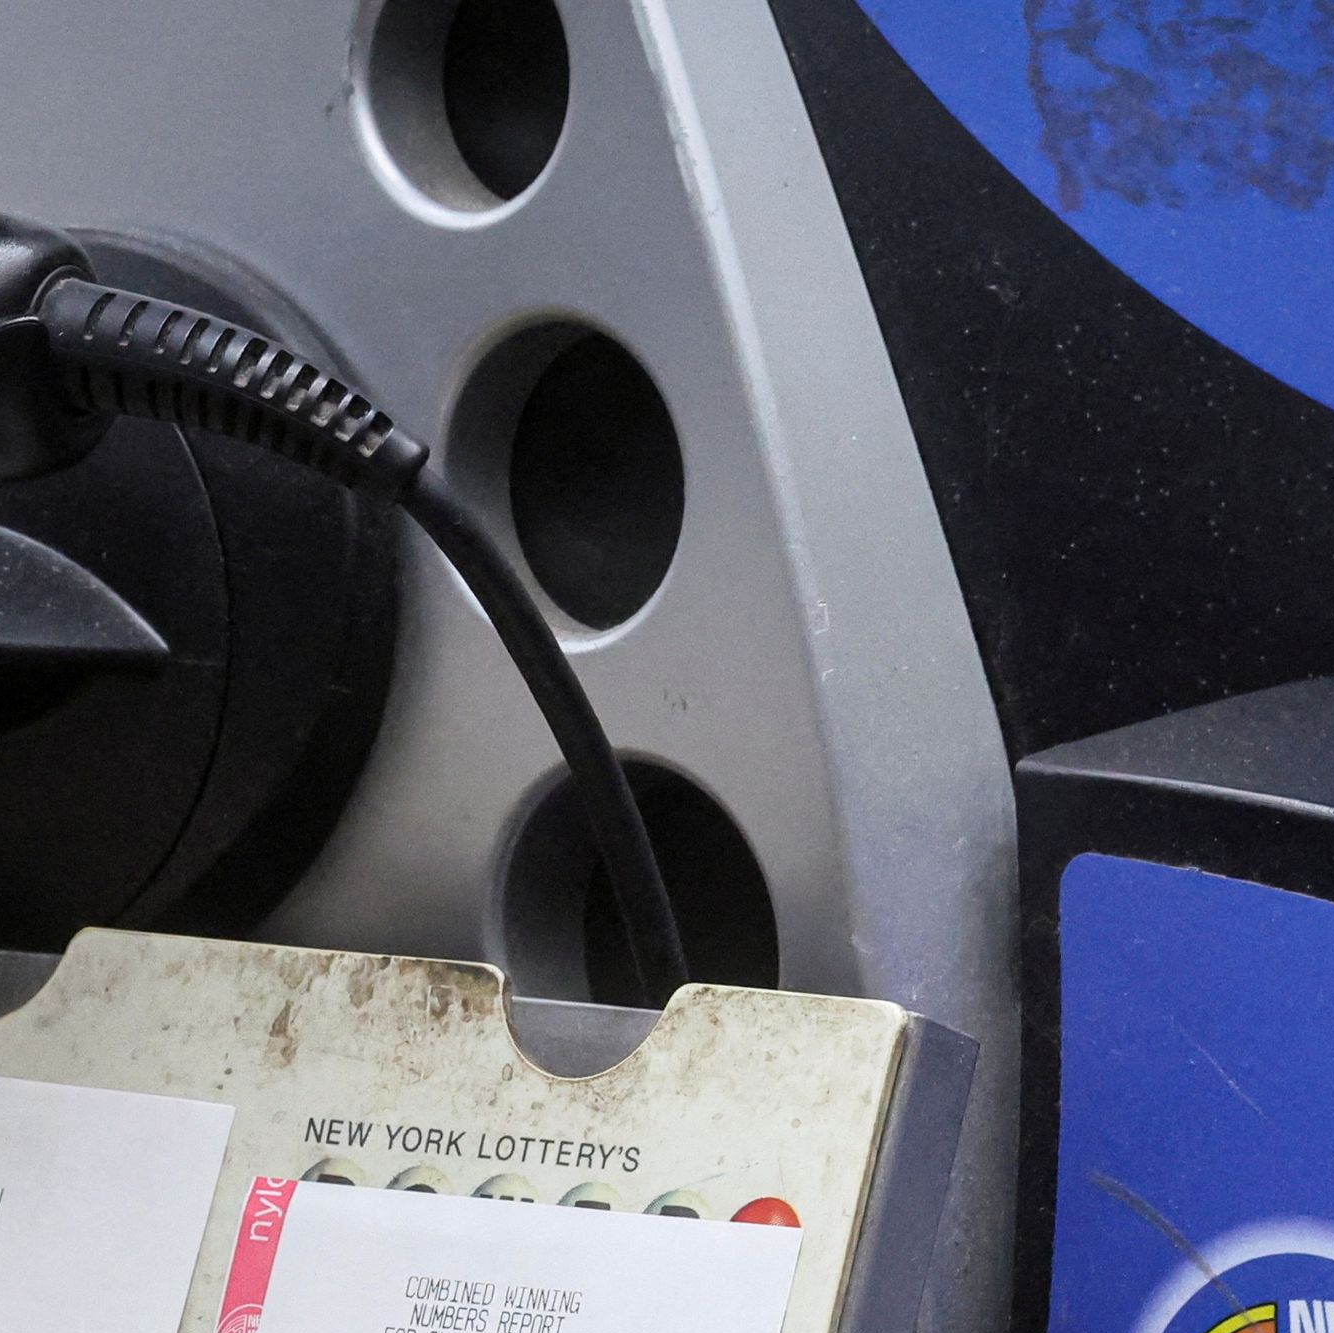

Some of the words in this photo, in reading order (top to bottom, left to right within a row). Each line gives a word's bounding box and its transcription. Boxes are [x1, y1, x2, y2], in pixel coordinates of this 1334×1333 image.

[305, 1117, 373, 1148] NEW
[385, 1124, 466, 1157] YORK
[477, 1133, 641, 1173] LOTTERY'S
[405, 1276, 495, 1306] COMBINED
[505, 1285, 583, 1314] WINNING
[410, 1303, 489, 1333] NUMBERS
